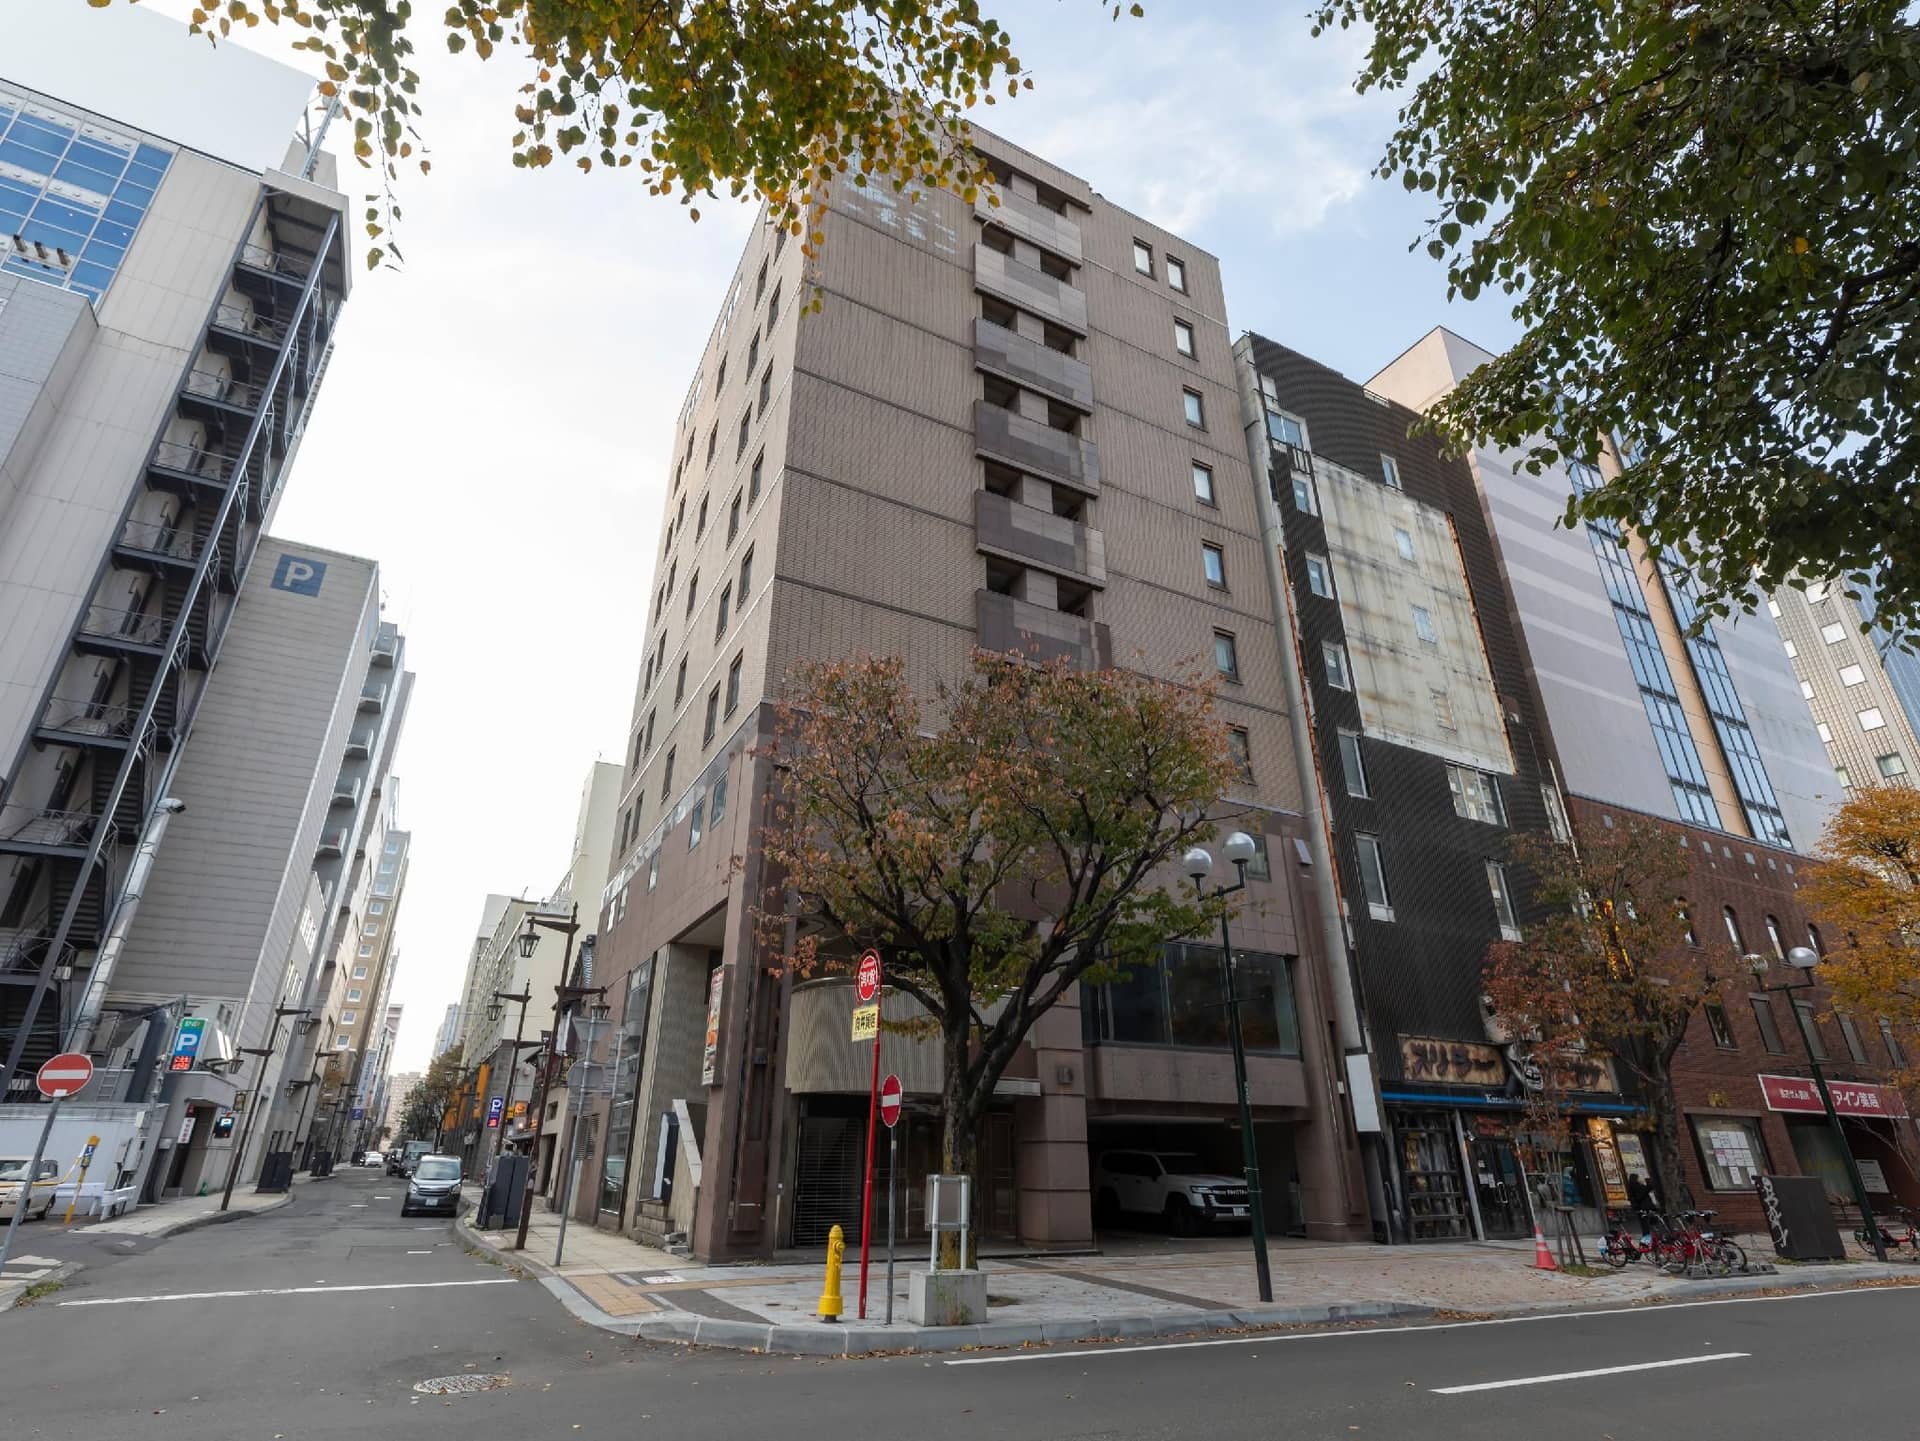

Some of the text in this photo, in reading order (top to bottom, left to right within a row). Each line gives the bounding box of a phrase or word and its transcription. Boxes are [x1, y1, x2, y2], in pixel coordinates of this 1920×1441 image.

[283, 561, 314, 587] P
[176, 1033, 198, 1051] P
[491, 1099, 502, 1112] P
[220, 1118, 232, 1127] P
